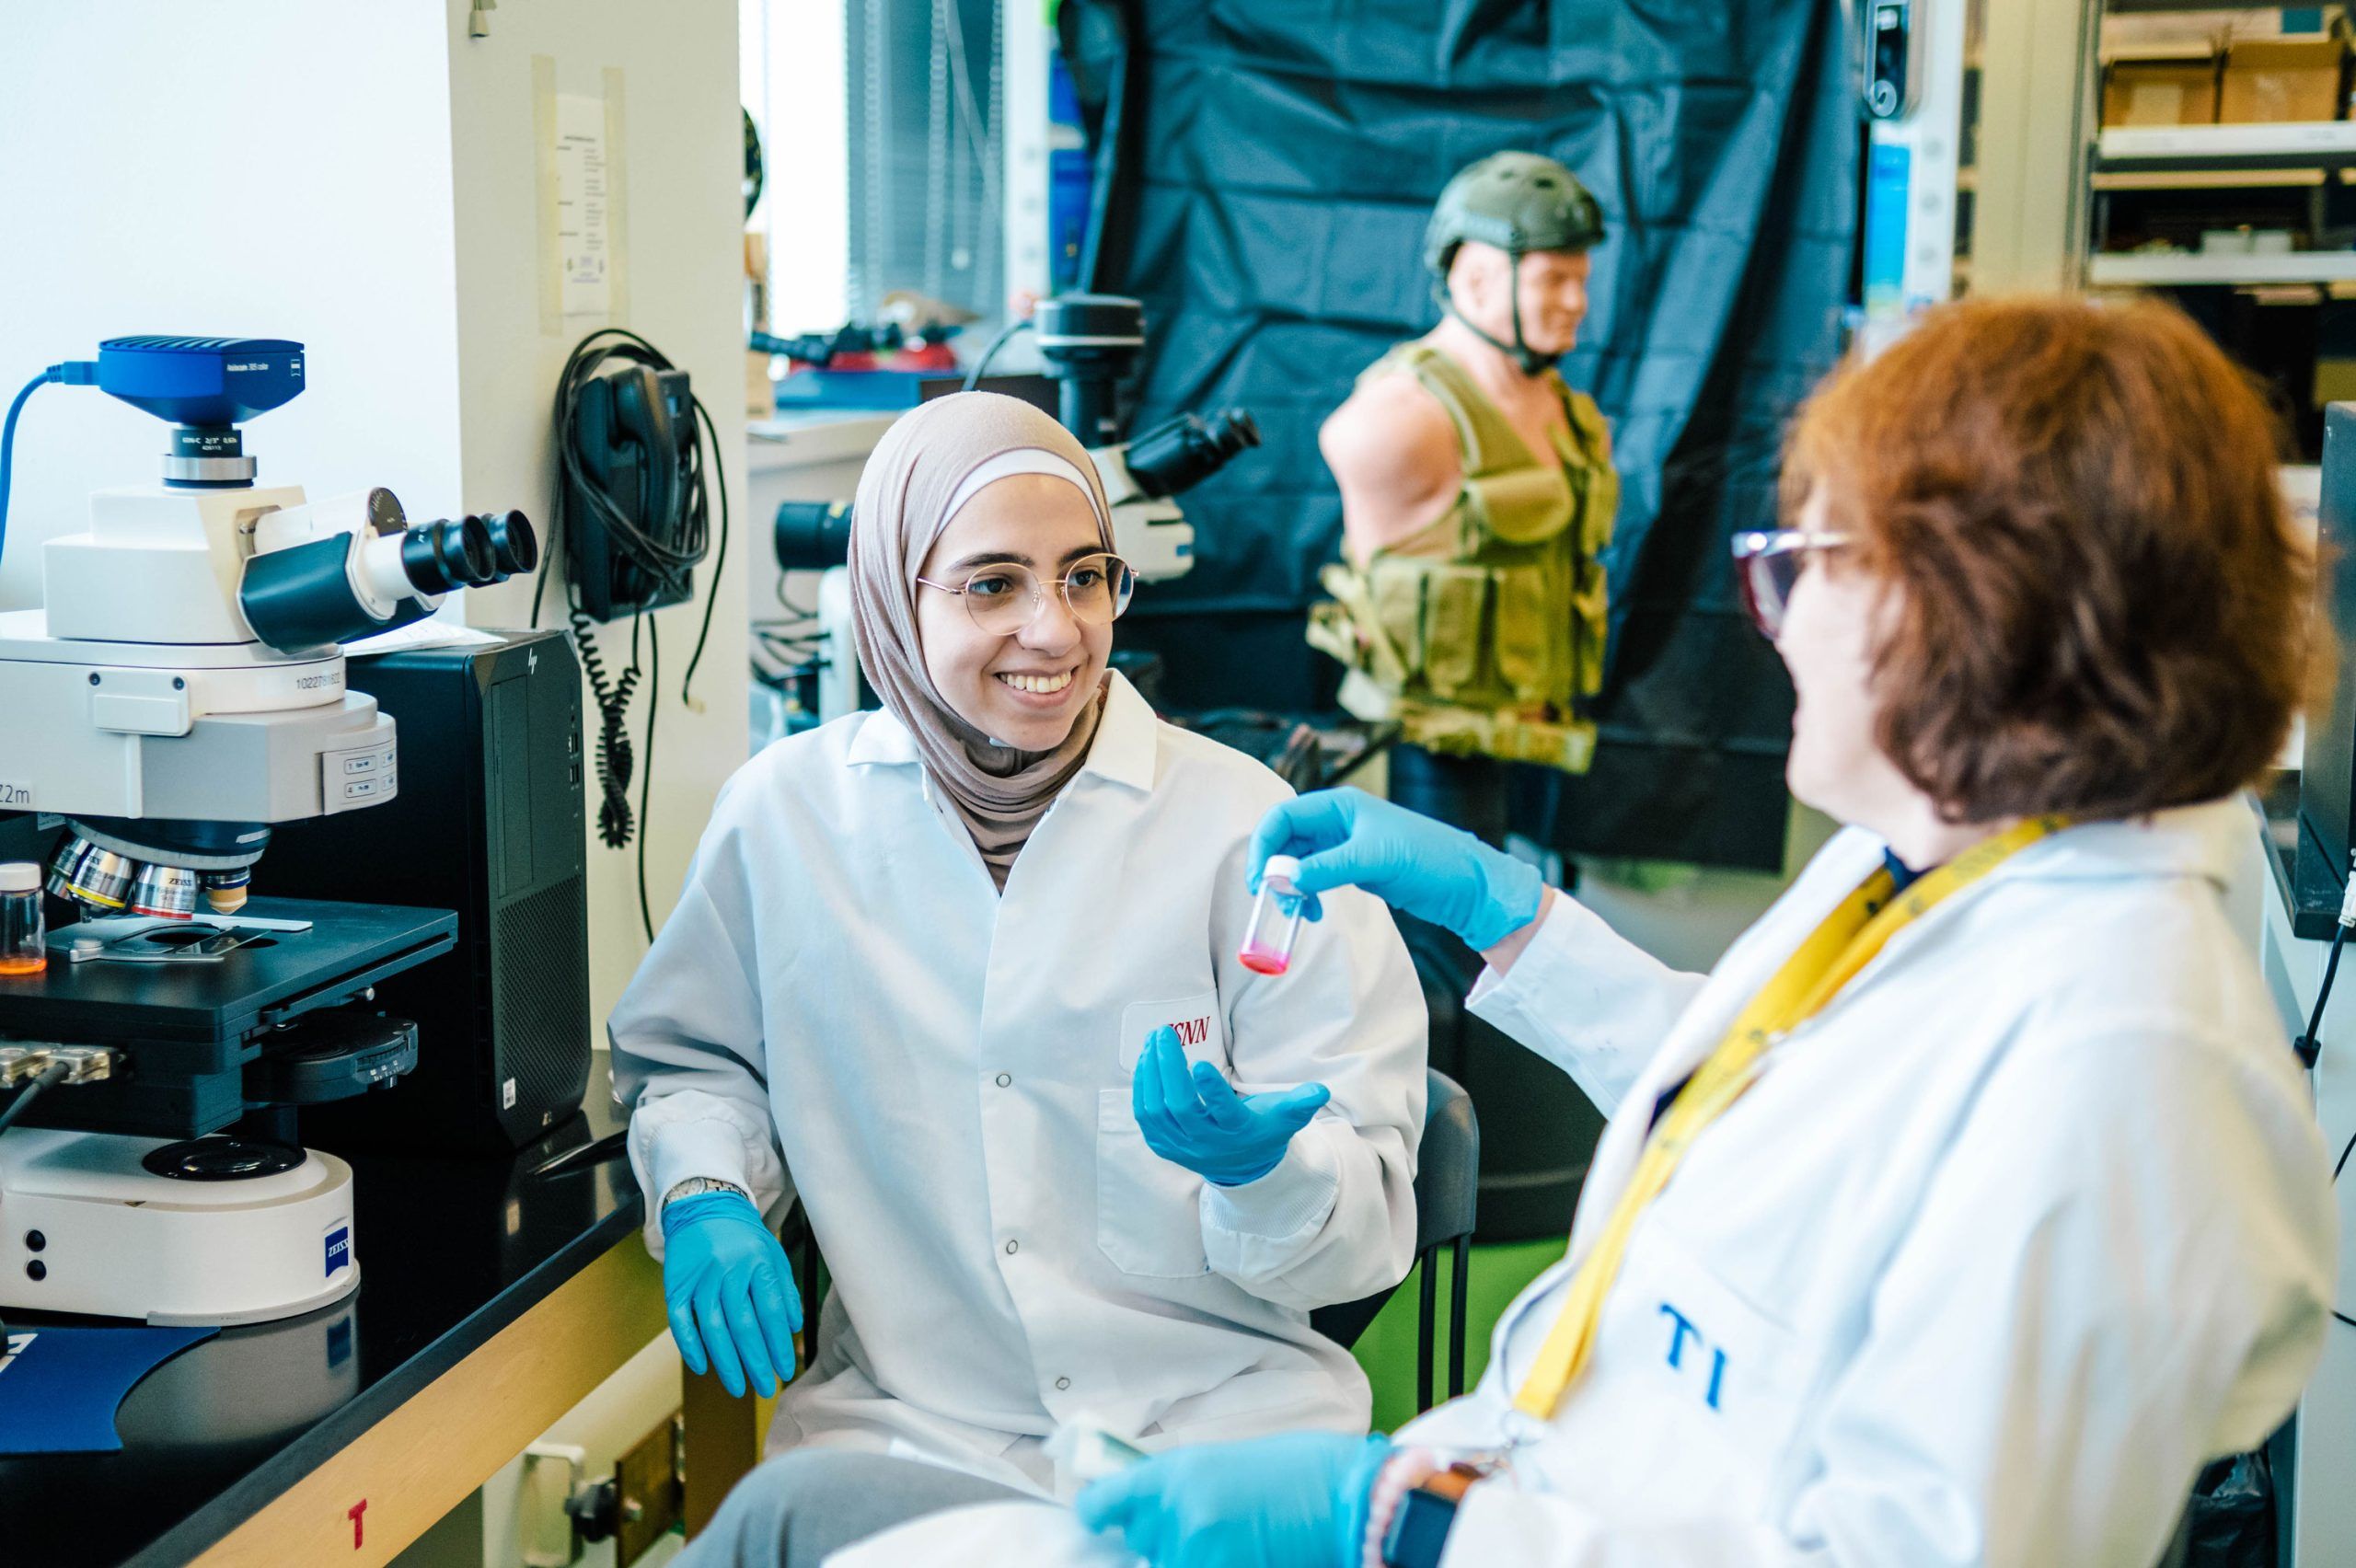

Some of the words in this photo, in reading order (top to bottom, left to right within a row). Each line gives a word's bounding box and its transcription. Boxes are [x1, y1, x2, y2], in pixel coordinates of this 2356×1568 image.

[168, 877, 192, 887] ZEISS
[1169, 1016, 1210, 1046] SNN
[347, 1497, 368, 1551] T
